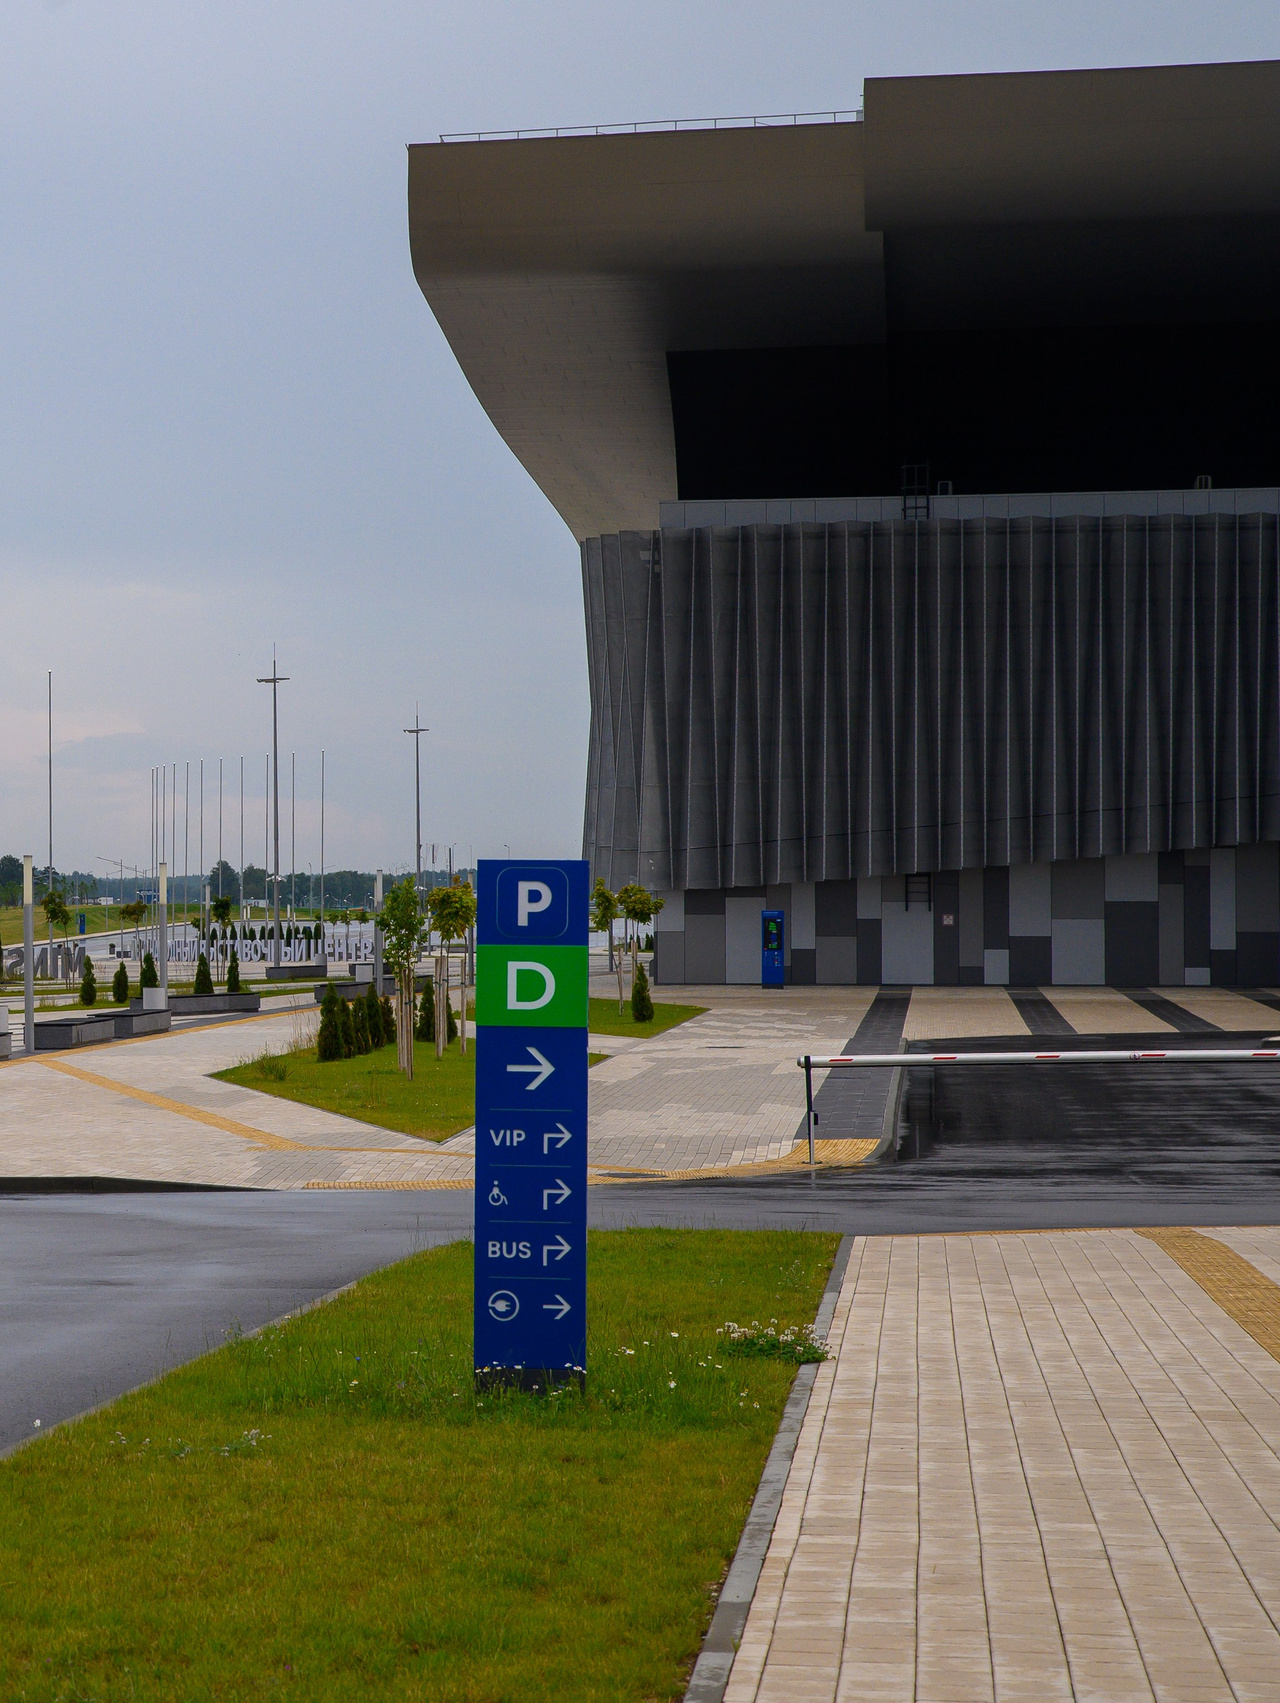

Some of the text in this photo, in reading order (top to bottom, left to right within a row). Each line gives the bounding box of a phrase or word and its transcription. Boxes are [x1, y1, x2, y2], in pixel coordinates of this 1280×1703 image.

[517, 881, 552, 926] P
[507, 961, 555, 1010] D
[490, 1129, 526, 1146] VIP
[487, 1241, 531, 1258] BUS
